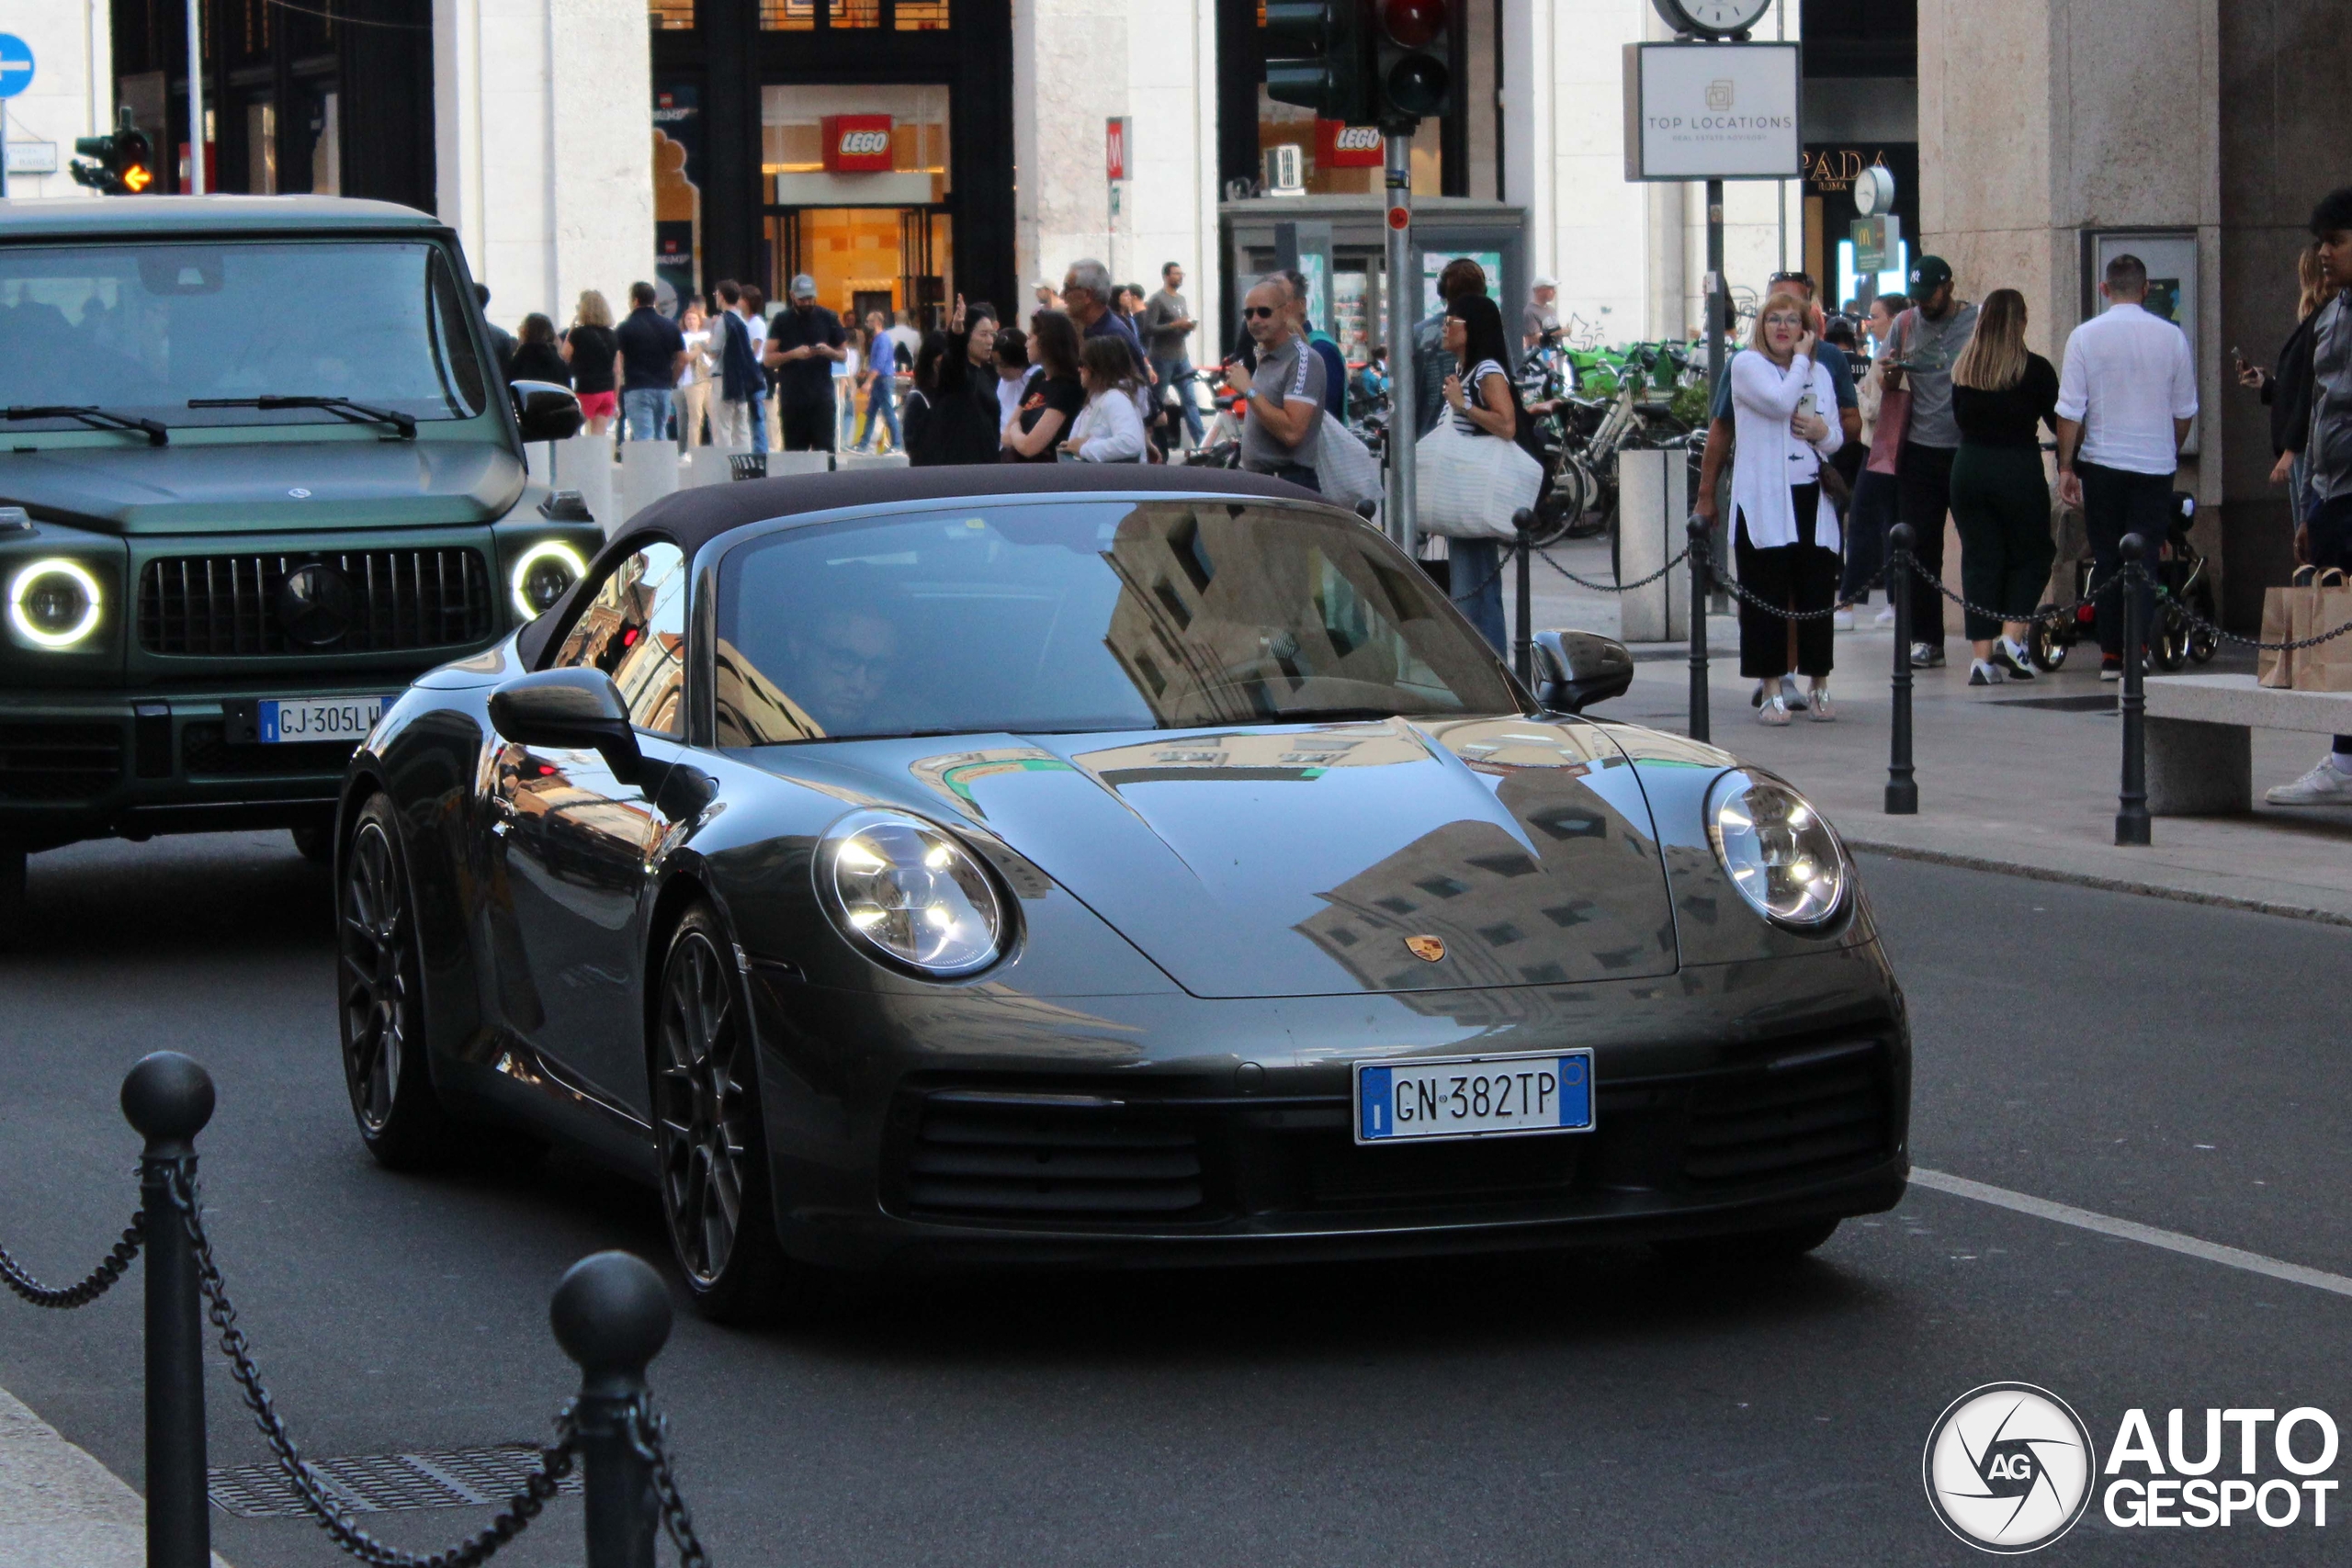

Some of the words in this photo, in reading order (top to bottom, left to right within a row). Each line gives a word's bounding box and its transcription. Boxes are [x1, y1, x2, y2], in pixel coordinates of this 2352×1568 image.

[1647, 117, 1682, 130] TOP
[1691, 116, 1792, 129] LOCATIONS
[839, 130, 889, 155] LEGO
[1335, 127, 1382, 151] LEGO
